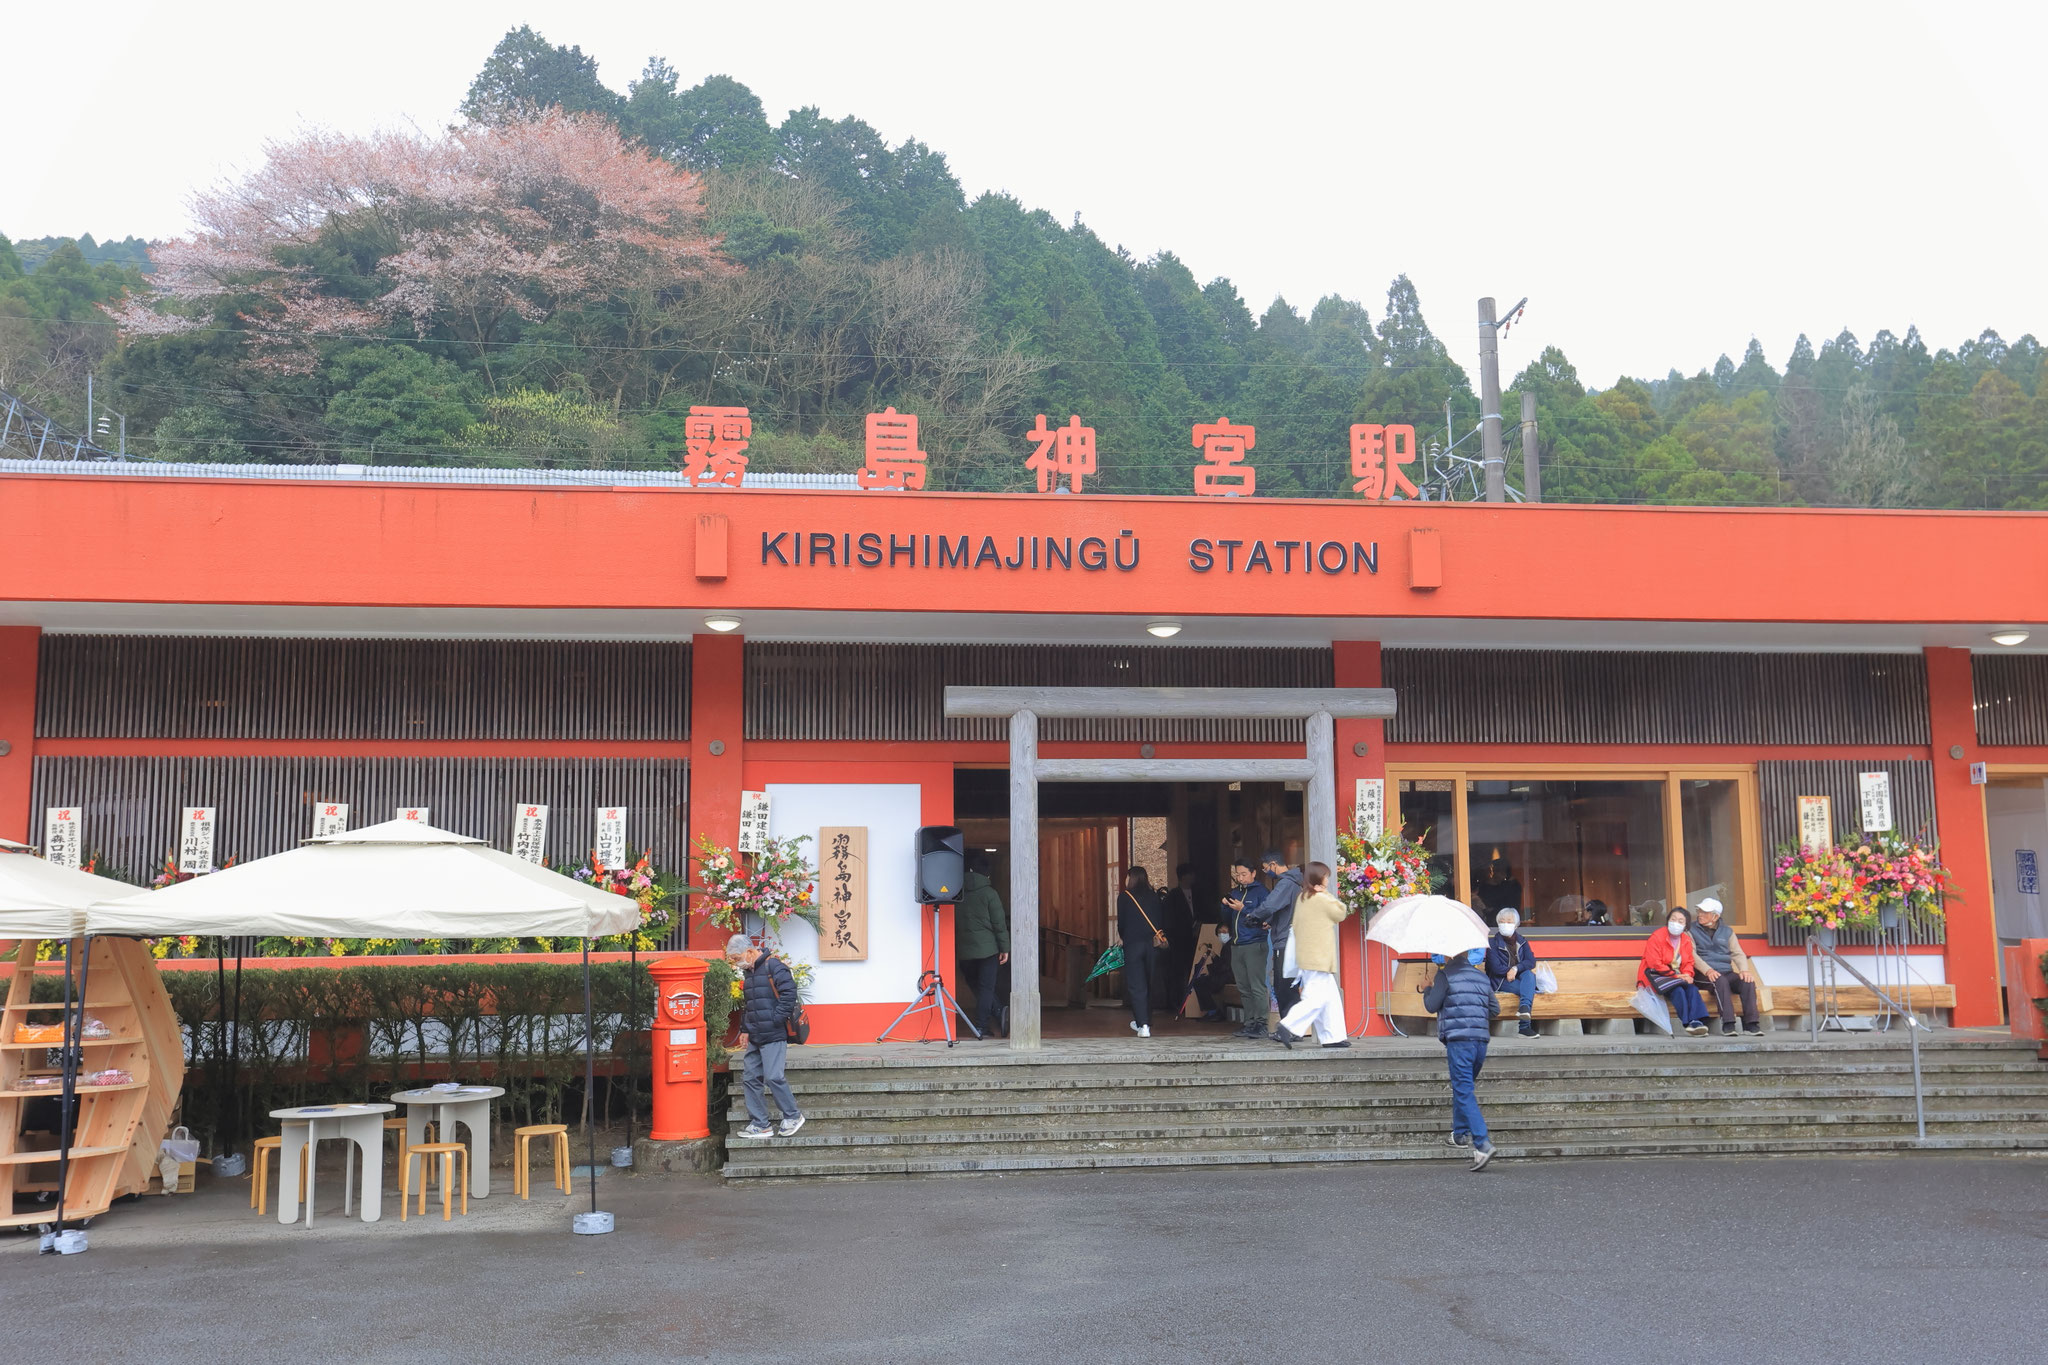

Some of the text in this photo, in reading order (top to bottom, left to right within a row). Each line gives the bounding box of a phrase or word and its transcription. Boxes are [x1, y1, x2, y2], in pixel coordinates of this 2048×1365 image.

[682, 406, 1420, 500] 霧島神宮駅
[761, 529, 1379, 575] KIRISHIMAJINGŪ STATION
[57, 809, 71, 821] 祝
[192, 809, 206, 821] 祝
[325, 805, 338, 817] 祝
[406, 810, 419, 821] 祝
[525, 806, 539, 818] 祝
[605, 809, 618, 820] 祝
[516, 832, 531, 861] 竹内秀
[673, 1008, 696, 1016] POST
